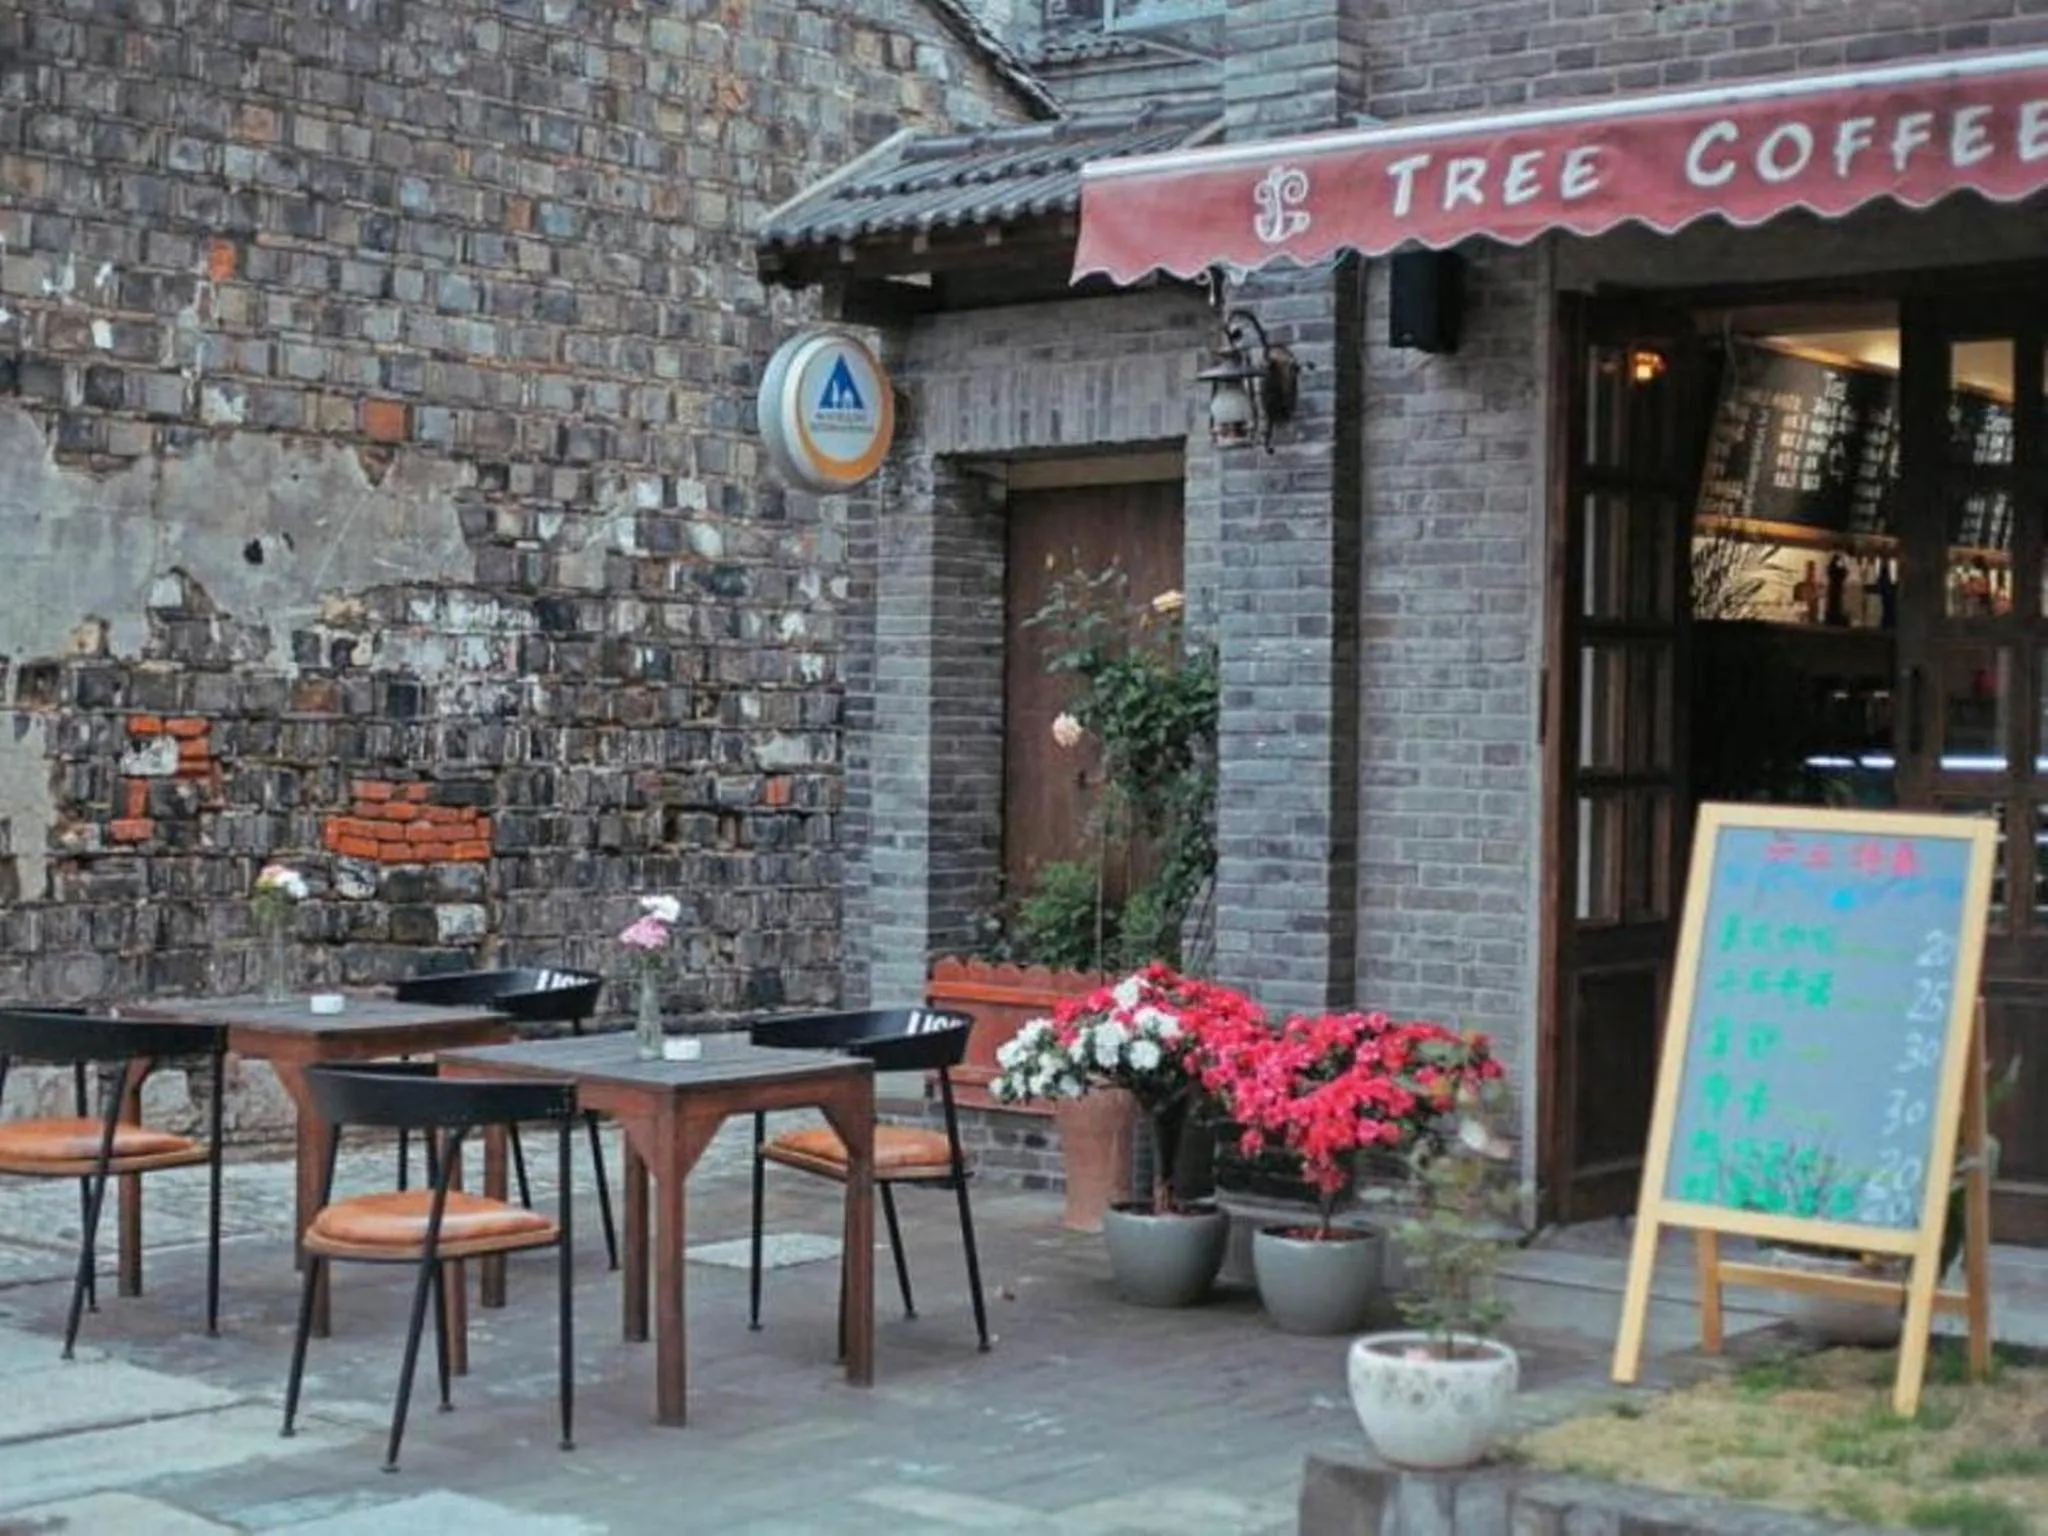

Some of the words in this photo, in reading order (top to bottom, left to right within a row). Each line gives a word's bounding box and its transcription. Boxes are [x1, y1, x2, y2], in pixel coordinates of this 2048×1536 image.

[1385, 145, 1603, 218] TREE
[1684, 98, 2048, 187] COFFEE
[1906, 977, 1950, 1022] 25
